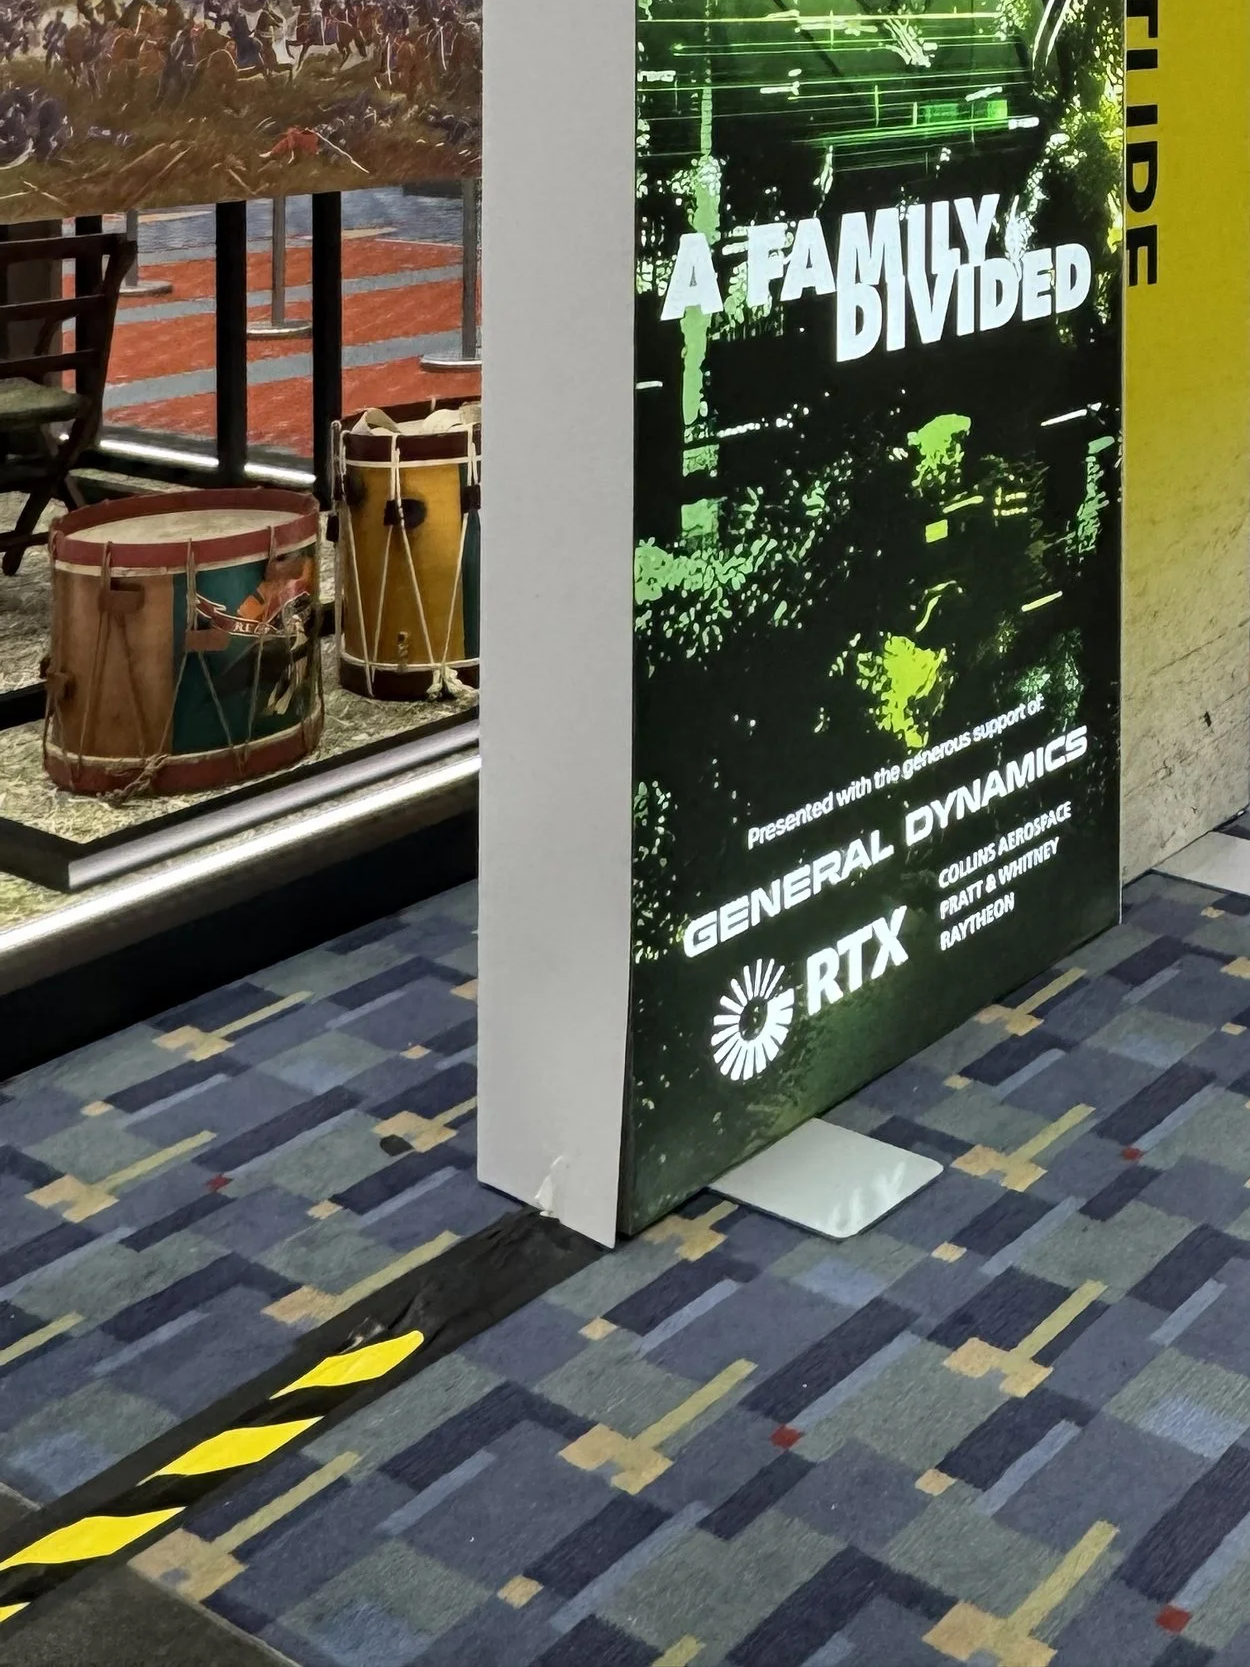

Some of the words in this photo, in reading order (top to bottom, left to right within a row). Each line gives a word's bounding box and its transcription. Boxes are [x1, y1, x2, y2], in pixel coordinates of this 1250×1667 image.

[660, 232, 724, 322] A
[747, 193, 1001, 308] FAMILY
[836, 242, 1092, 363] DIVIDED
[747, 790, 834, 851] Presented
[836, 775, 872, 807] with
[873, 764, 901, 790] the
[901, 731, 972, 781] generous
[972, 702, 1027, 742] support
[683, 829, 895, 959] GENERAL
[905, 725, 1089, 847] DYNAMICS
[938, 842, 997, 889] COLLINS
[998, 800, 1072, 856] AEROSPACE
[939, 879, 984, 920] PRATT
[985, 873, 997, 894] &
[998, 836, 1060, 886] WHITNEY
[806, 905, 909, 1016] RTX
[939, 891, 1015, 951] RAYTHEON
